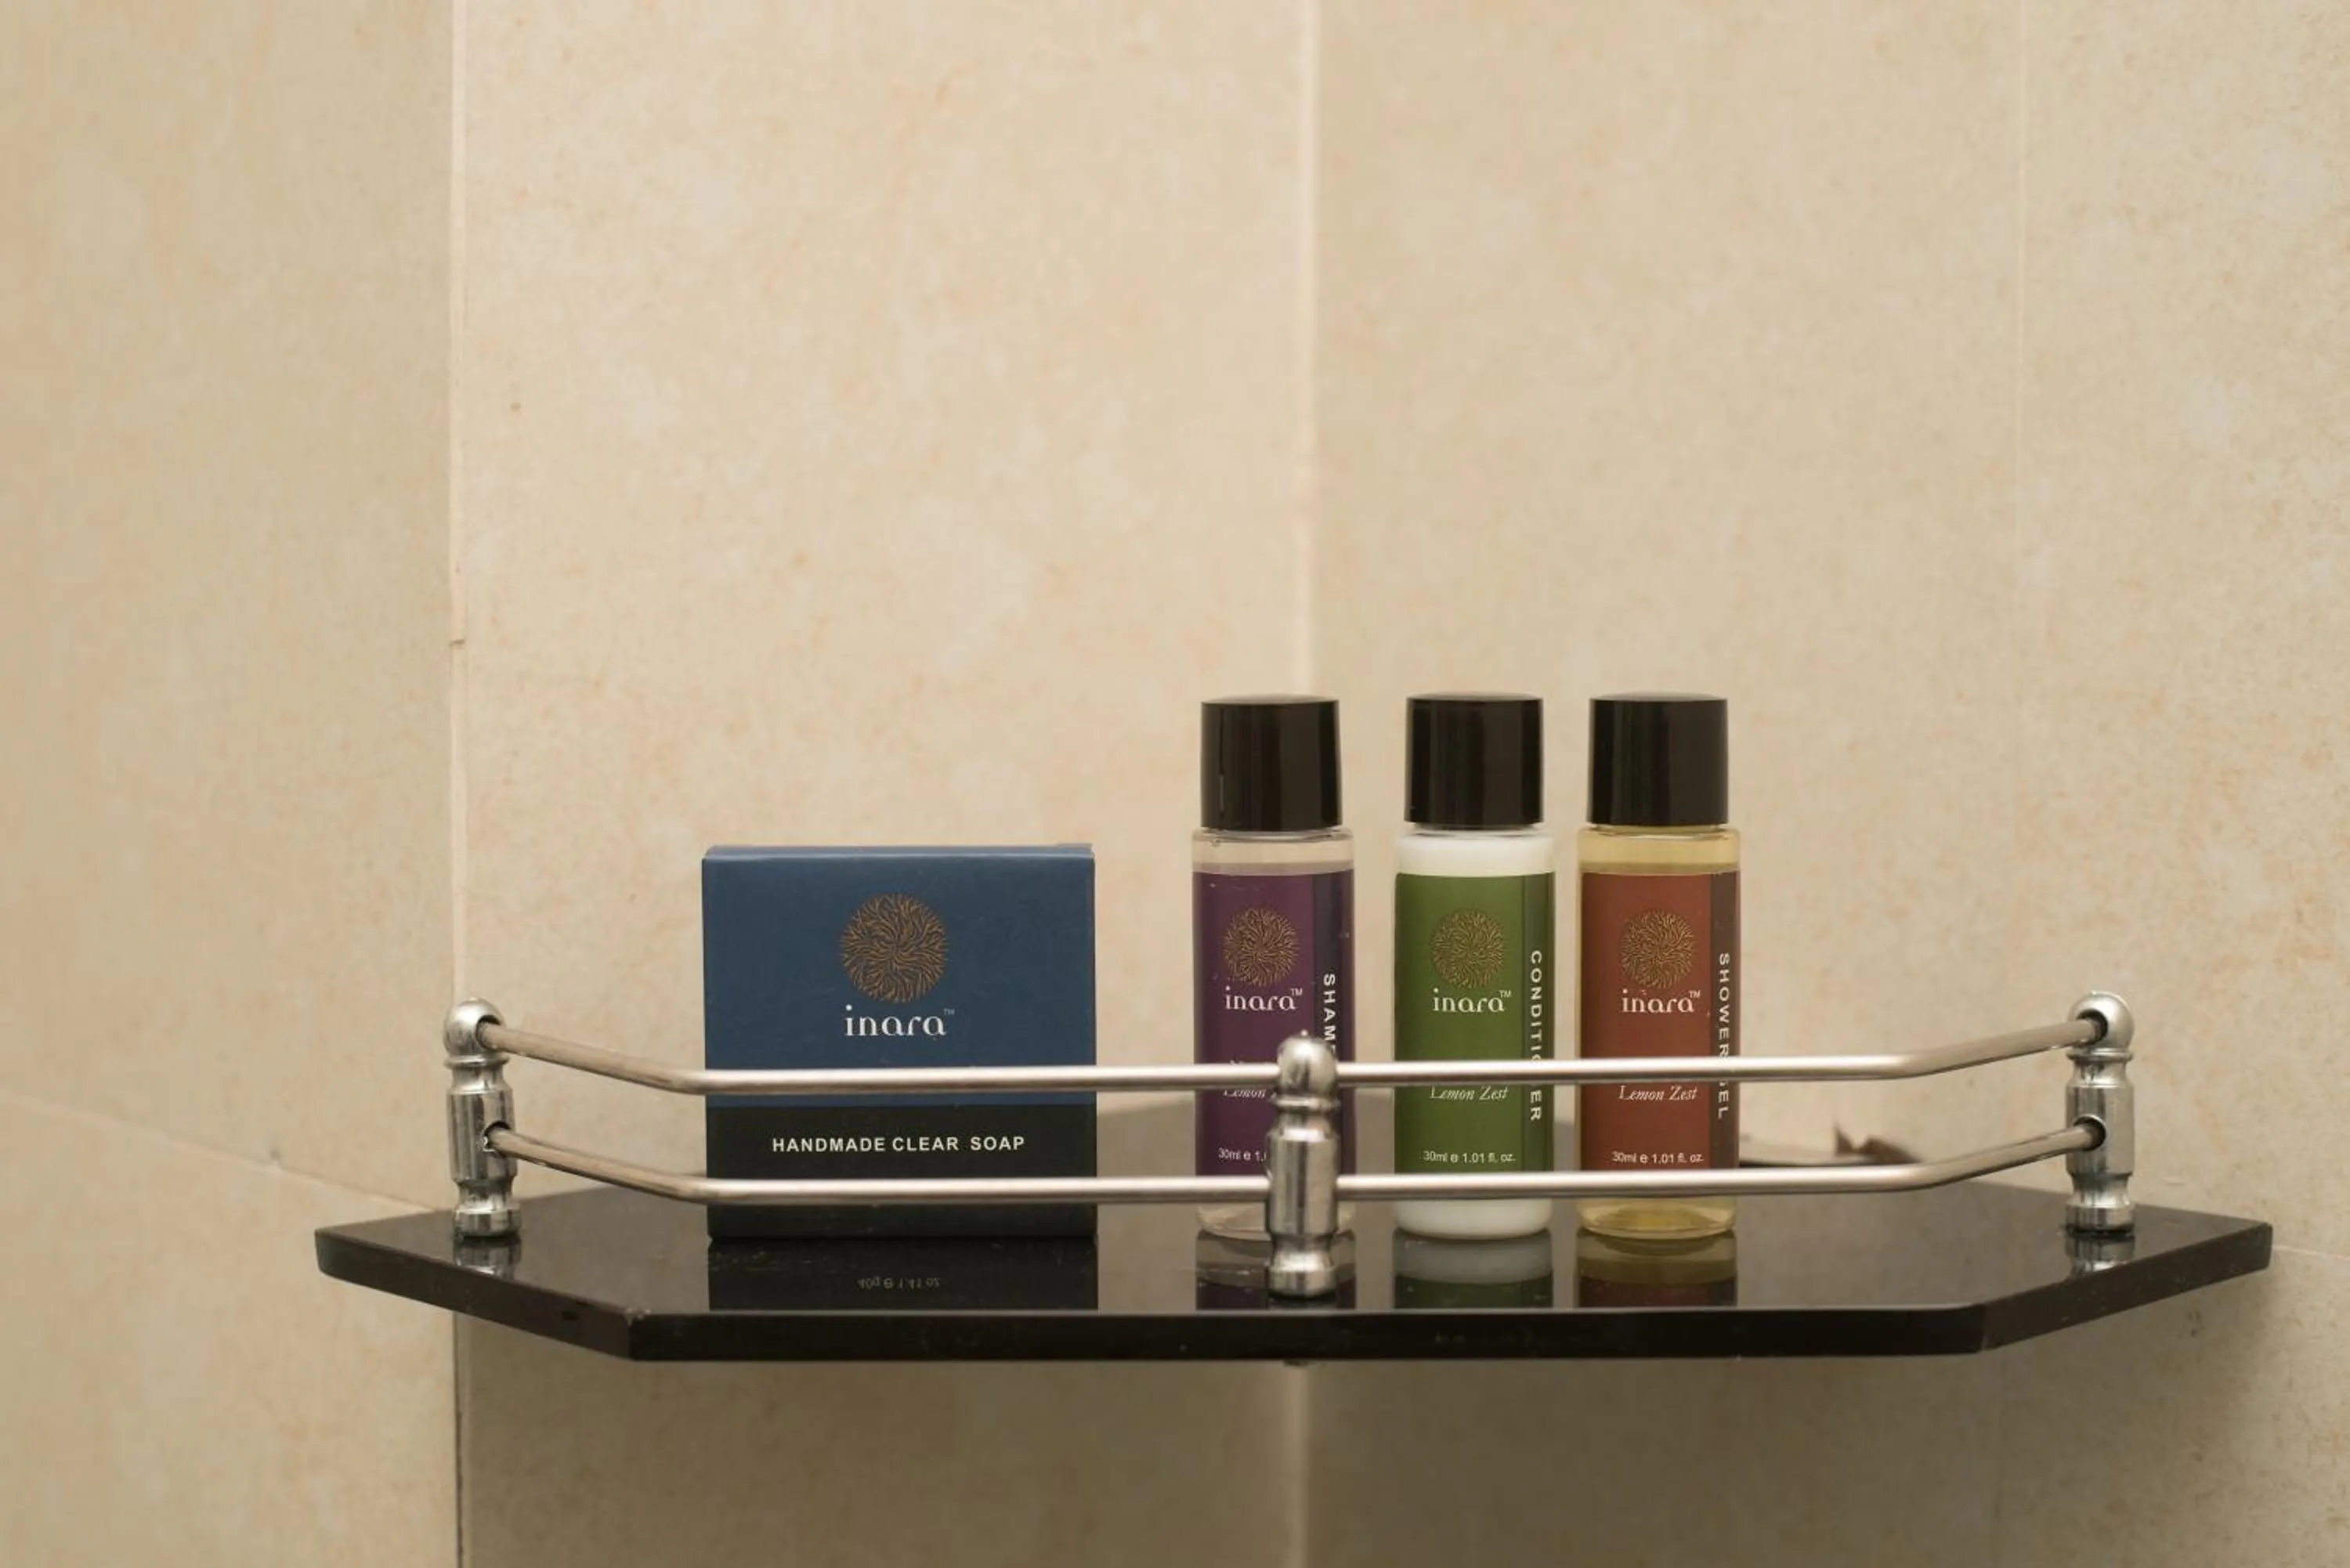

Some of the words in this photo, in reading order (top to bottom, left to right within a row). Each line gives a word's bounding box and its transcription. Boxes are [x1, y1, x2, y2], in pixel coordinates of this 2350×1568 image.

[1324, 974, 1336, 1055] SHAM
[1531, 950, 1542, 1121] CONDITIER
[1430, 1086, 1475, 1100] Lemon
[1479, 1086, 1508, 1100] Zest
[1618, 1085, 1665, 1100] Lemon
[1668, 1085, 1698, 1100] Zest
[773, 1138, 885, 1152] HANDMADE
[892, 1136, 959, 1151] CLEAR
[971, 1136, 1025, 1151] SOAP
[1423, 1151, 1448, 1162] 30ml
[1462, 1152, 1484, 1163] 1.01
[1612, 1151, 1637, 1163] 30ml
